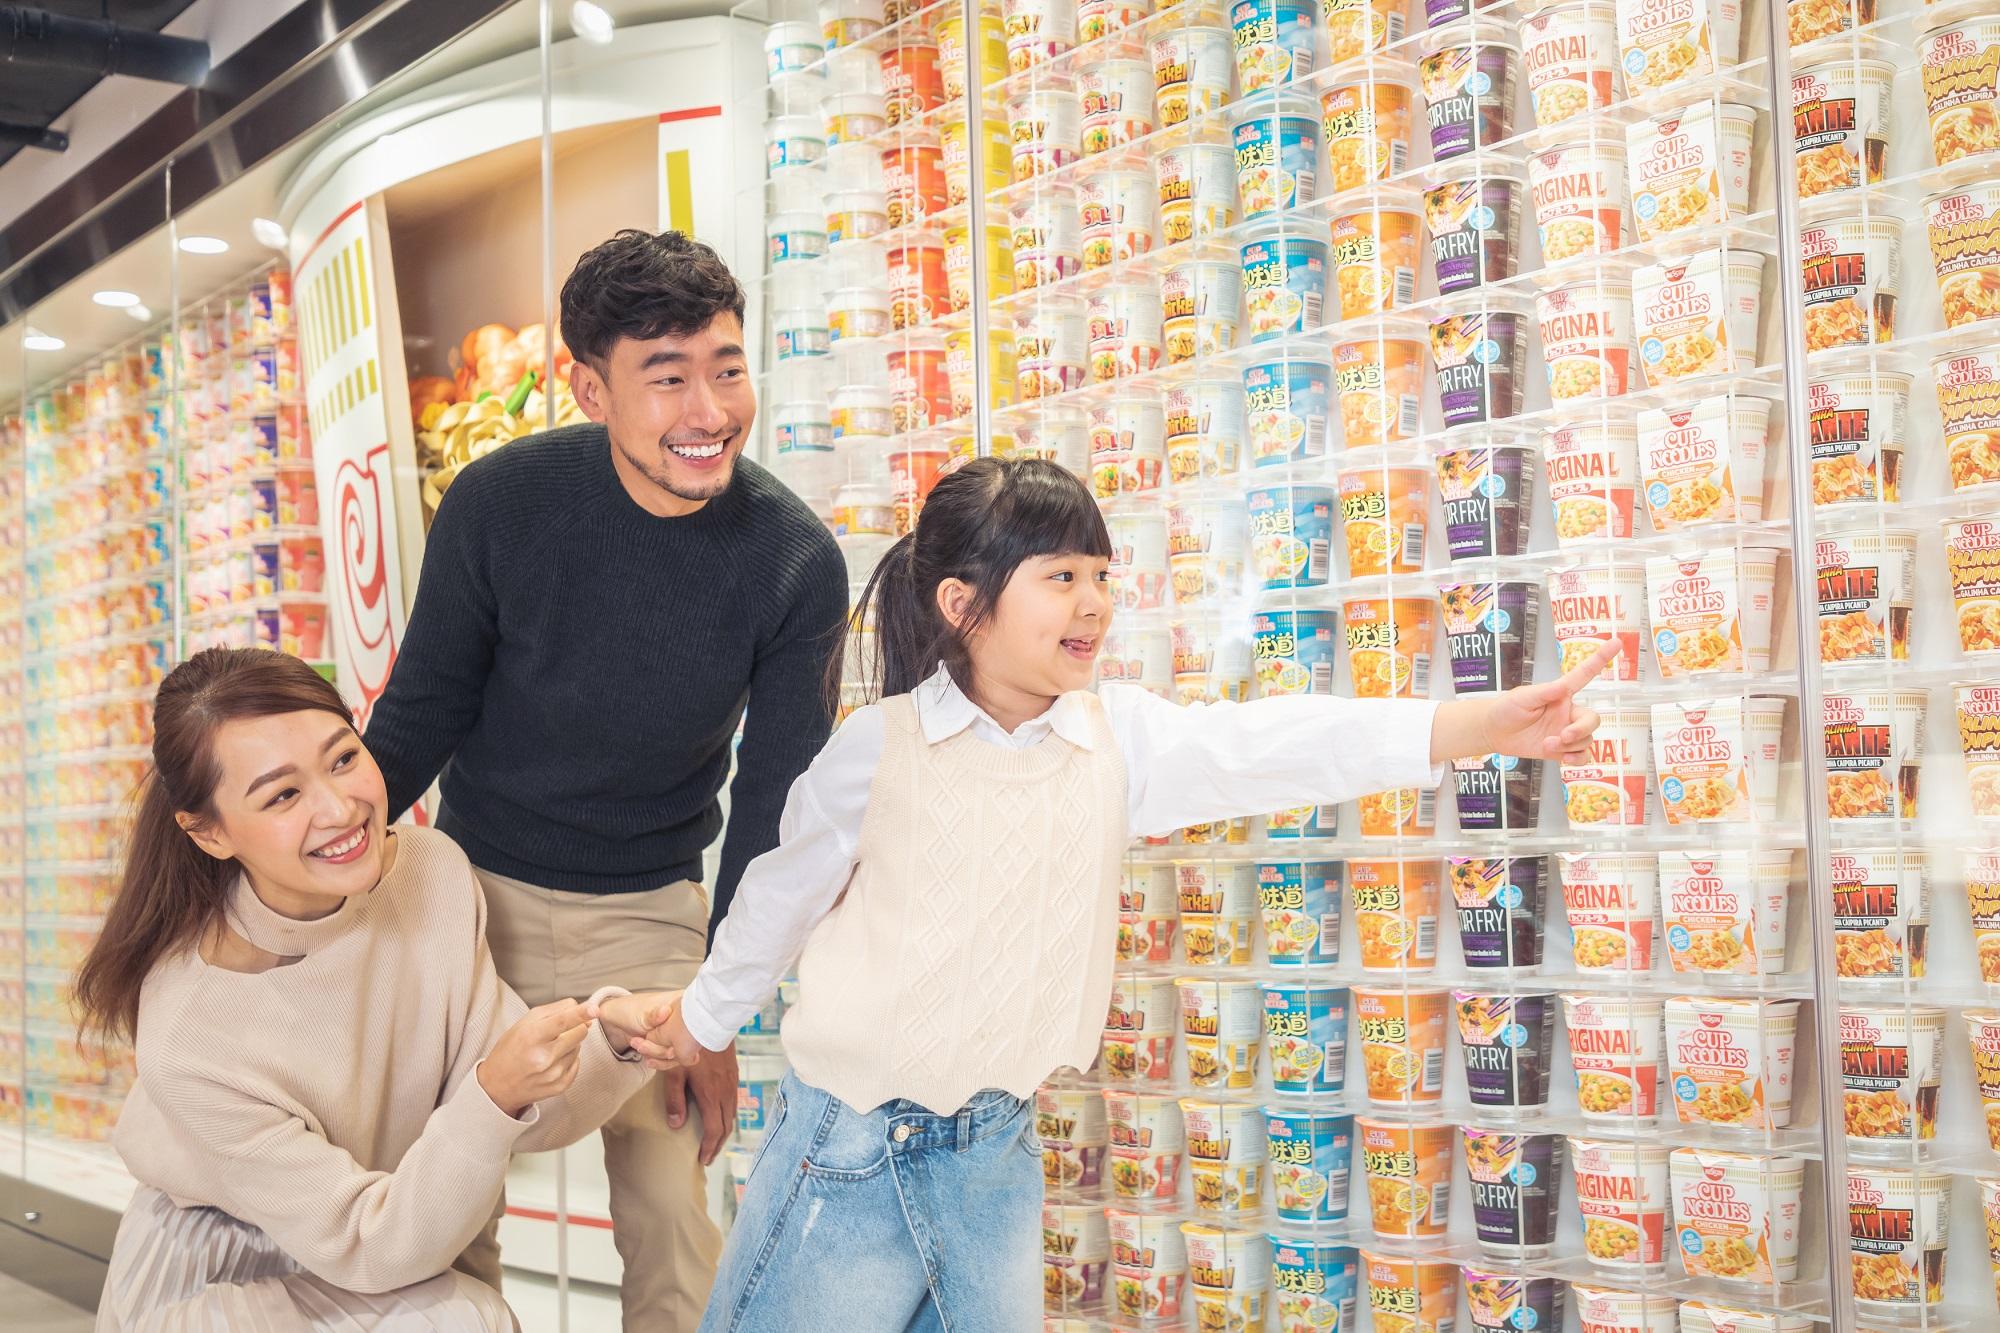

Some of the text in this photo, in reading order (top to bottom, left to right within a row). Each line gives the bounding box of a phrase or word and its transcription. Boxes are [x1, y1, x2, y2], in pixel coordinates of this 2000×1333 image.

[1628, 1, 1693, 36] NOODLES
[1934, 31, 1963, 50] CUP
[1926, 40, 1976, 66] NOODLES
[1443, 96, 1473, 122] FRY
[1793, 98, 1820, 116] LINHA
[1933, 91, 1994, 112] GALINHA CAIPIRA
[1795, 100, 1854, 138] ANTE
[1652, 134, 1688, 159] CUP
[1822, 133, 1845, 142] PICANTE
[1640, 146, 1703, 180] NOODLES
[1940, 195, 1970, 212] CUP
[1933, 204, 1984, 227] NOODLES
[1448, 230, 1477, 258] FRY
[1803, 252, 1831, 270] LINHA
[1942, 262, 1969, 274] GALINHA
[1804, 256, 1864, 293] ANTE
[1659, 281, 1696, 306] CUP
[1813, 288, 1855, 301] CAIPIRA PICANTE
[1645, 294, 1710, 326] NOODLES
[1948, 357, 1979, 374] CUP
[1453, 364, 1482, 388] FRY
[1941, 367, 1992, 388] NOODLES
[1809, 384, 1828, 398] UP
[1811, 411, 1868, 444] ANTE
[1949, 422, 1976, 433] GALINHA
[1664, 427, 1700, 450] CUP
[1835, 443, 1857, 452] PICANTE
[1650, 440, 1716, 470] NOODLES
[1460, 498, 1489, 522] FRY
[1961, 522, 1992, 537] CUP
[1816, 542, 1837, 555] UP
[1817, 566, 1843, 579] LINHA
[1673, 577, 1710, 599] CUP
[1817, 568, 1877, 601] ANTE
[1960, 588, 1988, 598] GALINHA
[1658, 592, 1724, 618] NOODLES
[1845, 601, 1867, 609] PICANTE
[1464, 634, 1492, 658] FRY
[1824, 698, 1852, 711] CUP
[1678, 726, 1716, 747] CUP
[1825, 722, 1857, 735] ALINHA
[1664, 741, 1730, 764] NOODLES
[1837, 759, 1881, 767] CAIPIRA PICANTE
[1470, 770, 1500, 794] FRY
[1832, 868, 1868, 881] ODLES
[1686, 878, 1722, 897] CUP
[1833, 881, 1862, 893] LINHA
[1672, 894, 1737, 914] NOODLES
[1834, 886, 1897, 916] ANTE
[1475, 908, 1505, 932] FRY
[1683, 916, 1716, 924] CHICKEN
[1843, 918, 1862, 926] CAIPIRA
[1840, 1015, 1868, 1029] CUP
[1693, 1030, 1732, 1048] CUP
[1982, 1025, 2000, 1040] CU
[1679, 1045, 1748, 1068] NOODLES
[1841, 1042, 1874, 1052] ALINHA
[1479, 1046, 1510, 1071] FRY
[1690, 1067, 1724, 1076] CHICKEN
[1854, 1079, 1898, 1087] CAIPIRA PICANTE
[1487, 1184, 1518, 1209] FRY
[1698, 1182, 1734, 1201] CUP
[1849, 1190, 1883, 1204] ODLES
[1684, 1198, 1750, 1223] NOODLES
[1849, 1204, 1877, 1215] LINHA
[1696, 1221, 1728, 1230] CHICKEN
[1851, 1211, 1912, 1240] ANTE
[1858, 1240, 1901, 1250] CAIPIRA PICANTE
